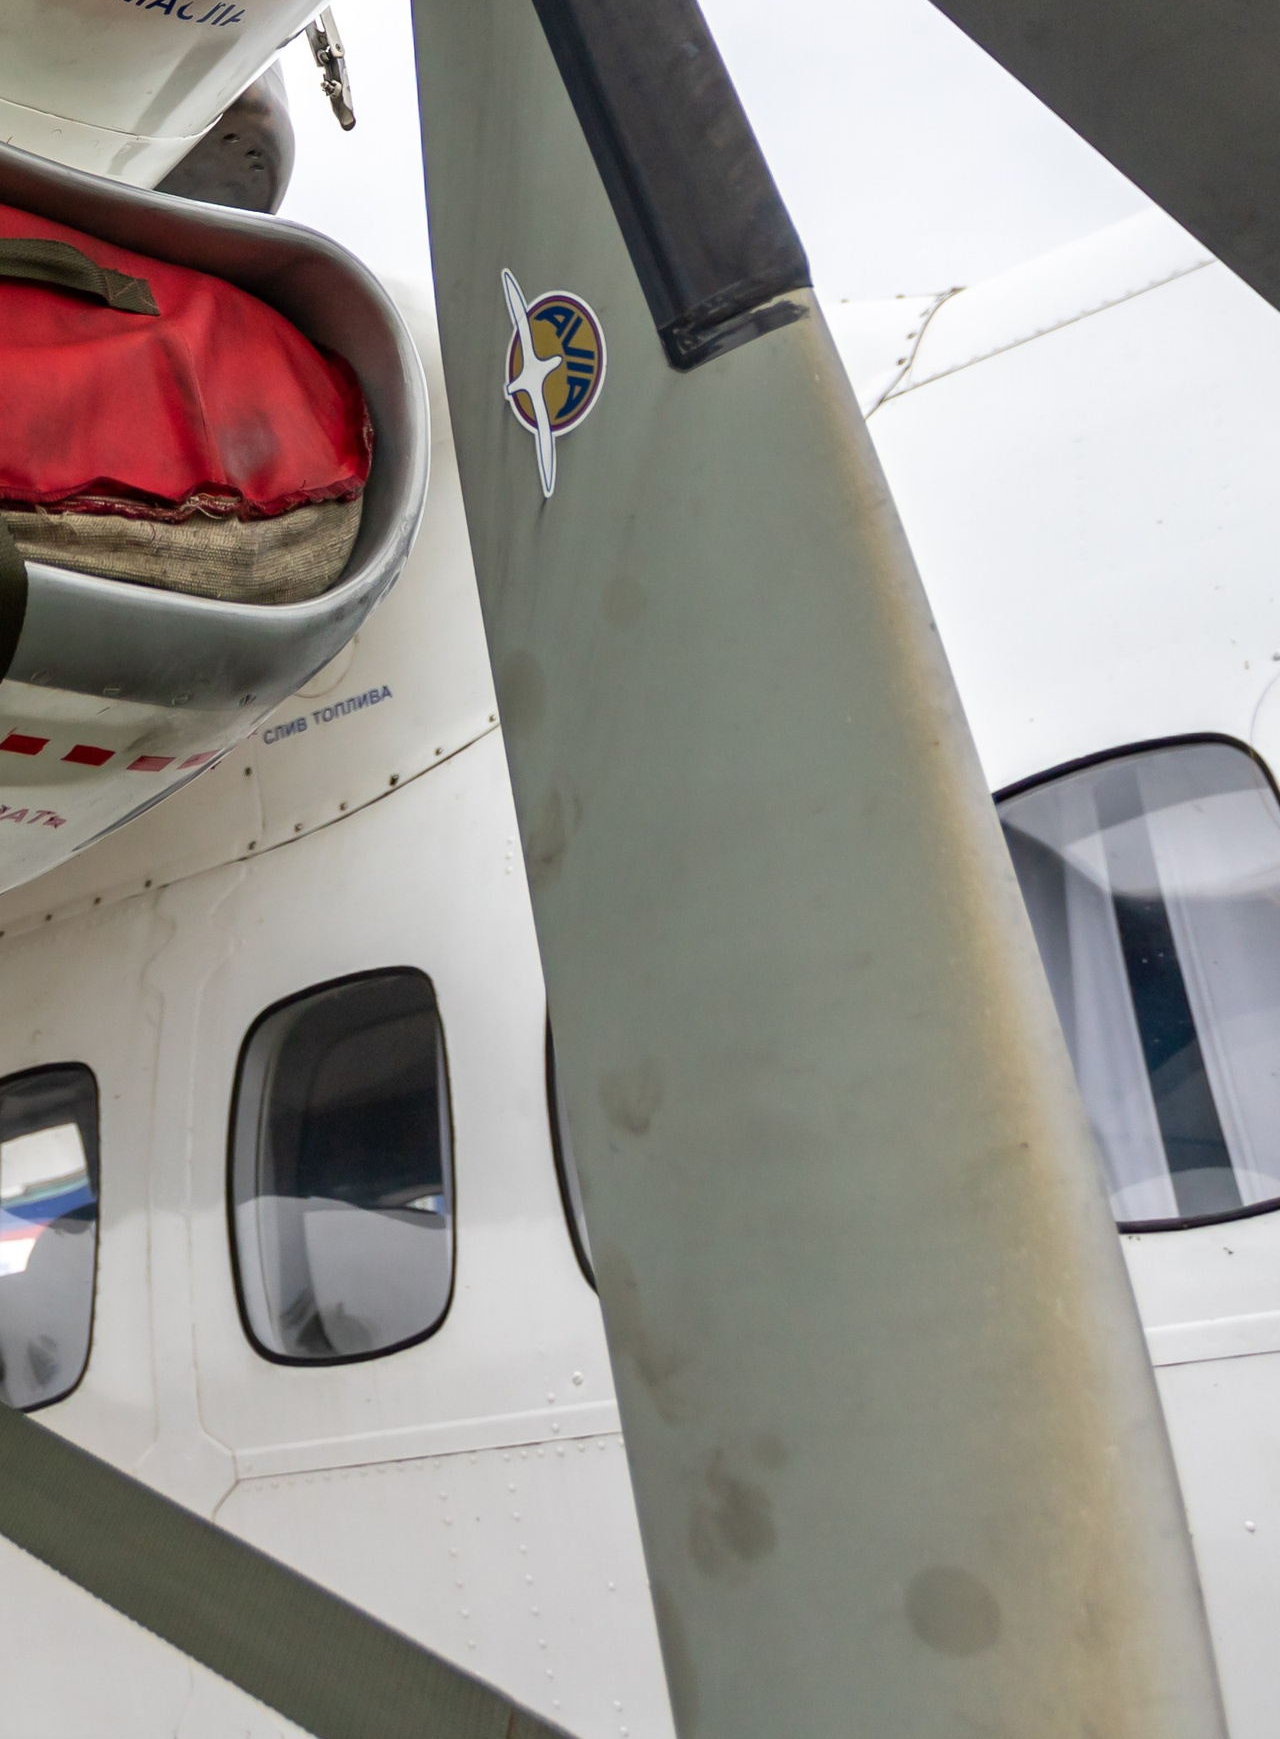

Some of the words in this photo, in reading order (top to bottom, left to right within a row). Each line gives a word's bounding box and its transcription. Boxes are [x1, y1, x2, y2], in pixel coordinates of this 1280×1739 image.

[533, 305, 595, 420] AVIA
[263, 717, 308, 744] СЛИВ
[311, 685, 393, 725] ТОПЛИВА
